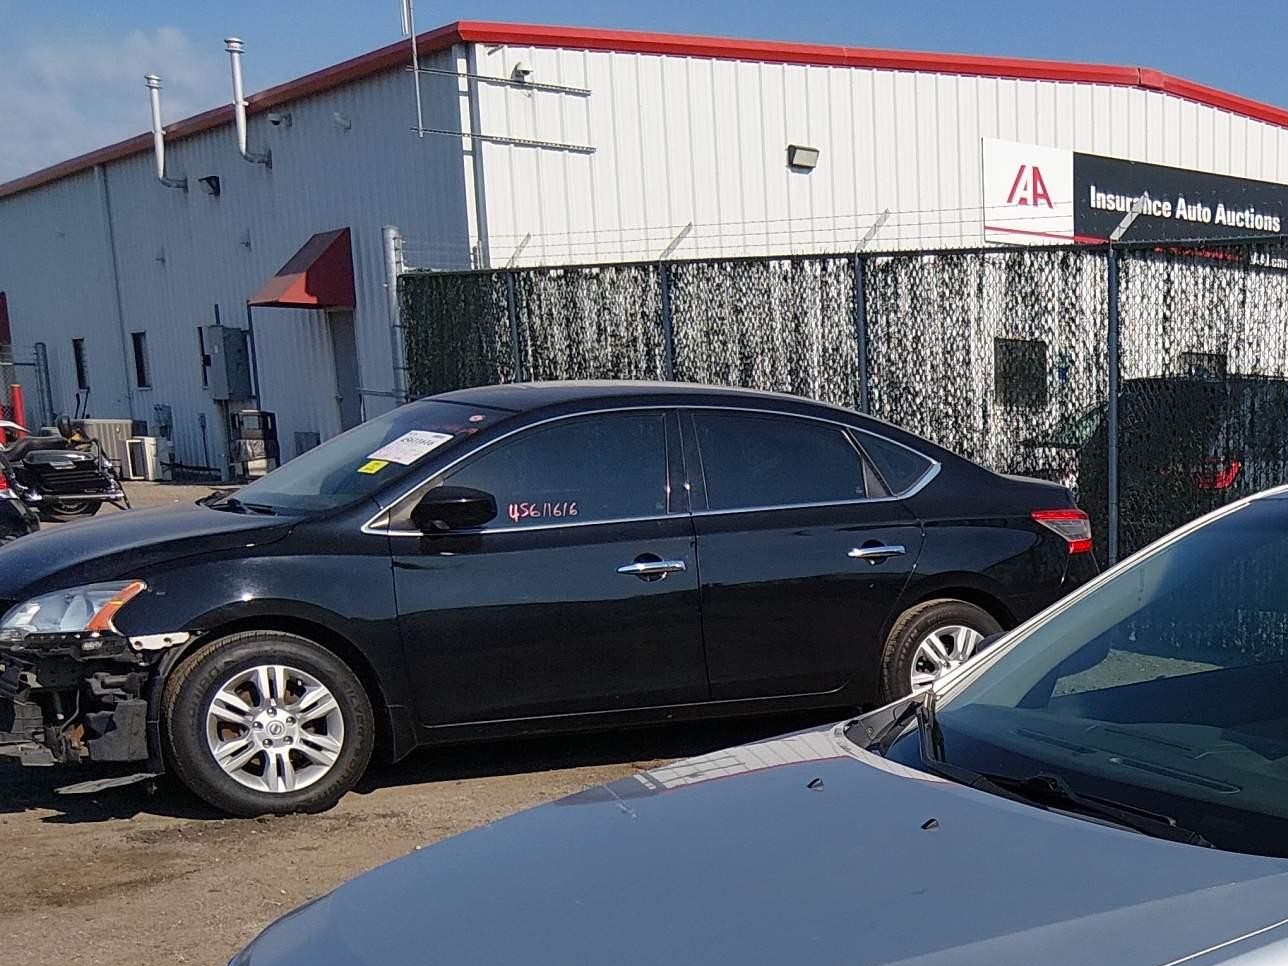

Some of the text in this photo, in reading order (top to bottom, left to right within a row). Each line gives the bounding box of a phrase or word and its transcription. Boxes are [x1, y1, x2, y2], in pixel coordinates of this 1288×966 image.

[1090, 184, 1281, 232] Insurnce Auto Auctions
